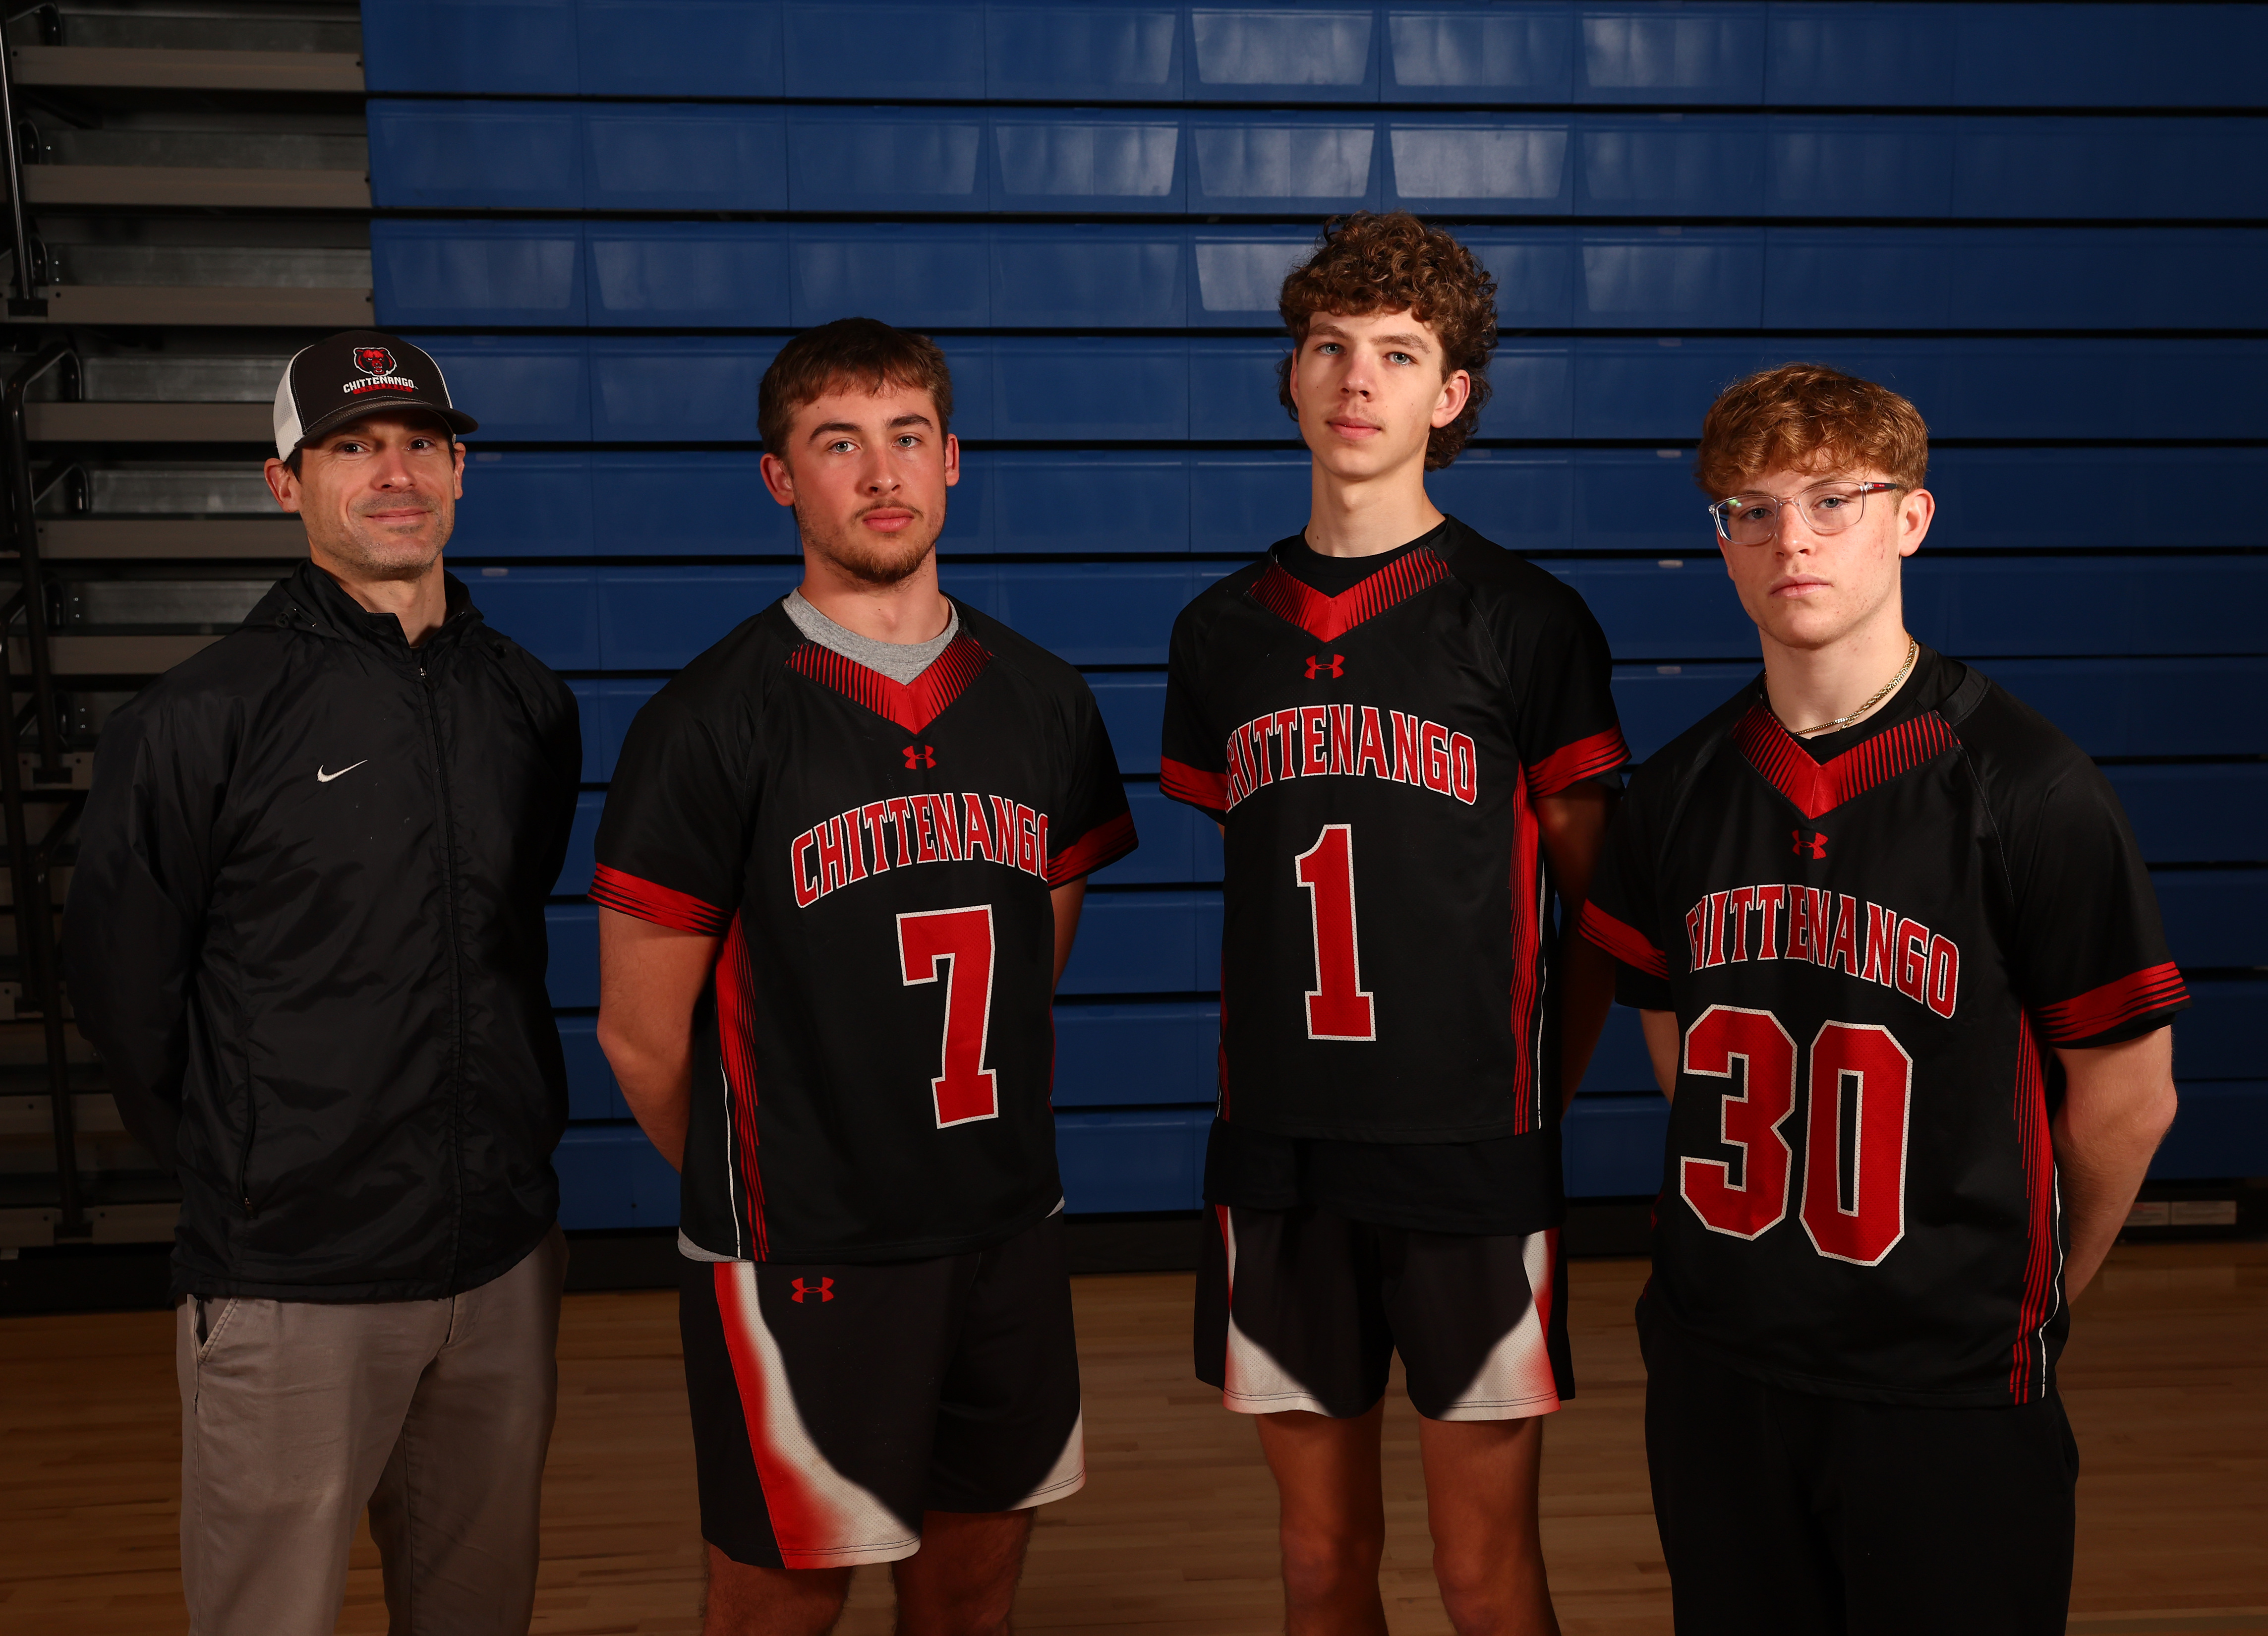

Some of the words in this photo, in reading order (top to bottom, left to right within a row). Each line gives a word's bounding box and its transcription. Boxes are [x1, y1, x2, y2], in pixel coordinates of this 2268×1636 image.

[343, 376, 414, 393] CHITTENANGO
[896, 904, 998, 1129] 7
[1295, 823, 1377, 1042] 1
[1681, 1004, 1913, 1267] 30
